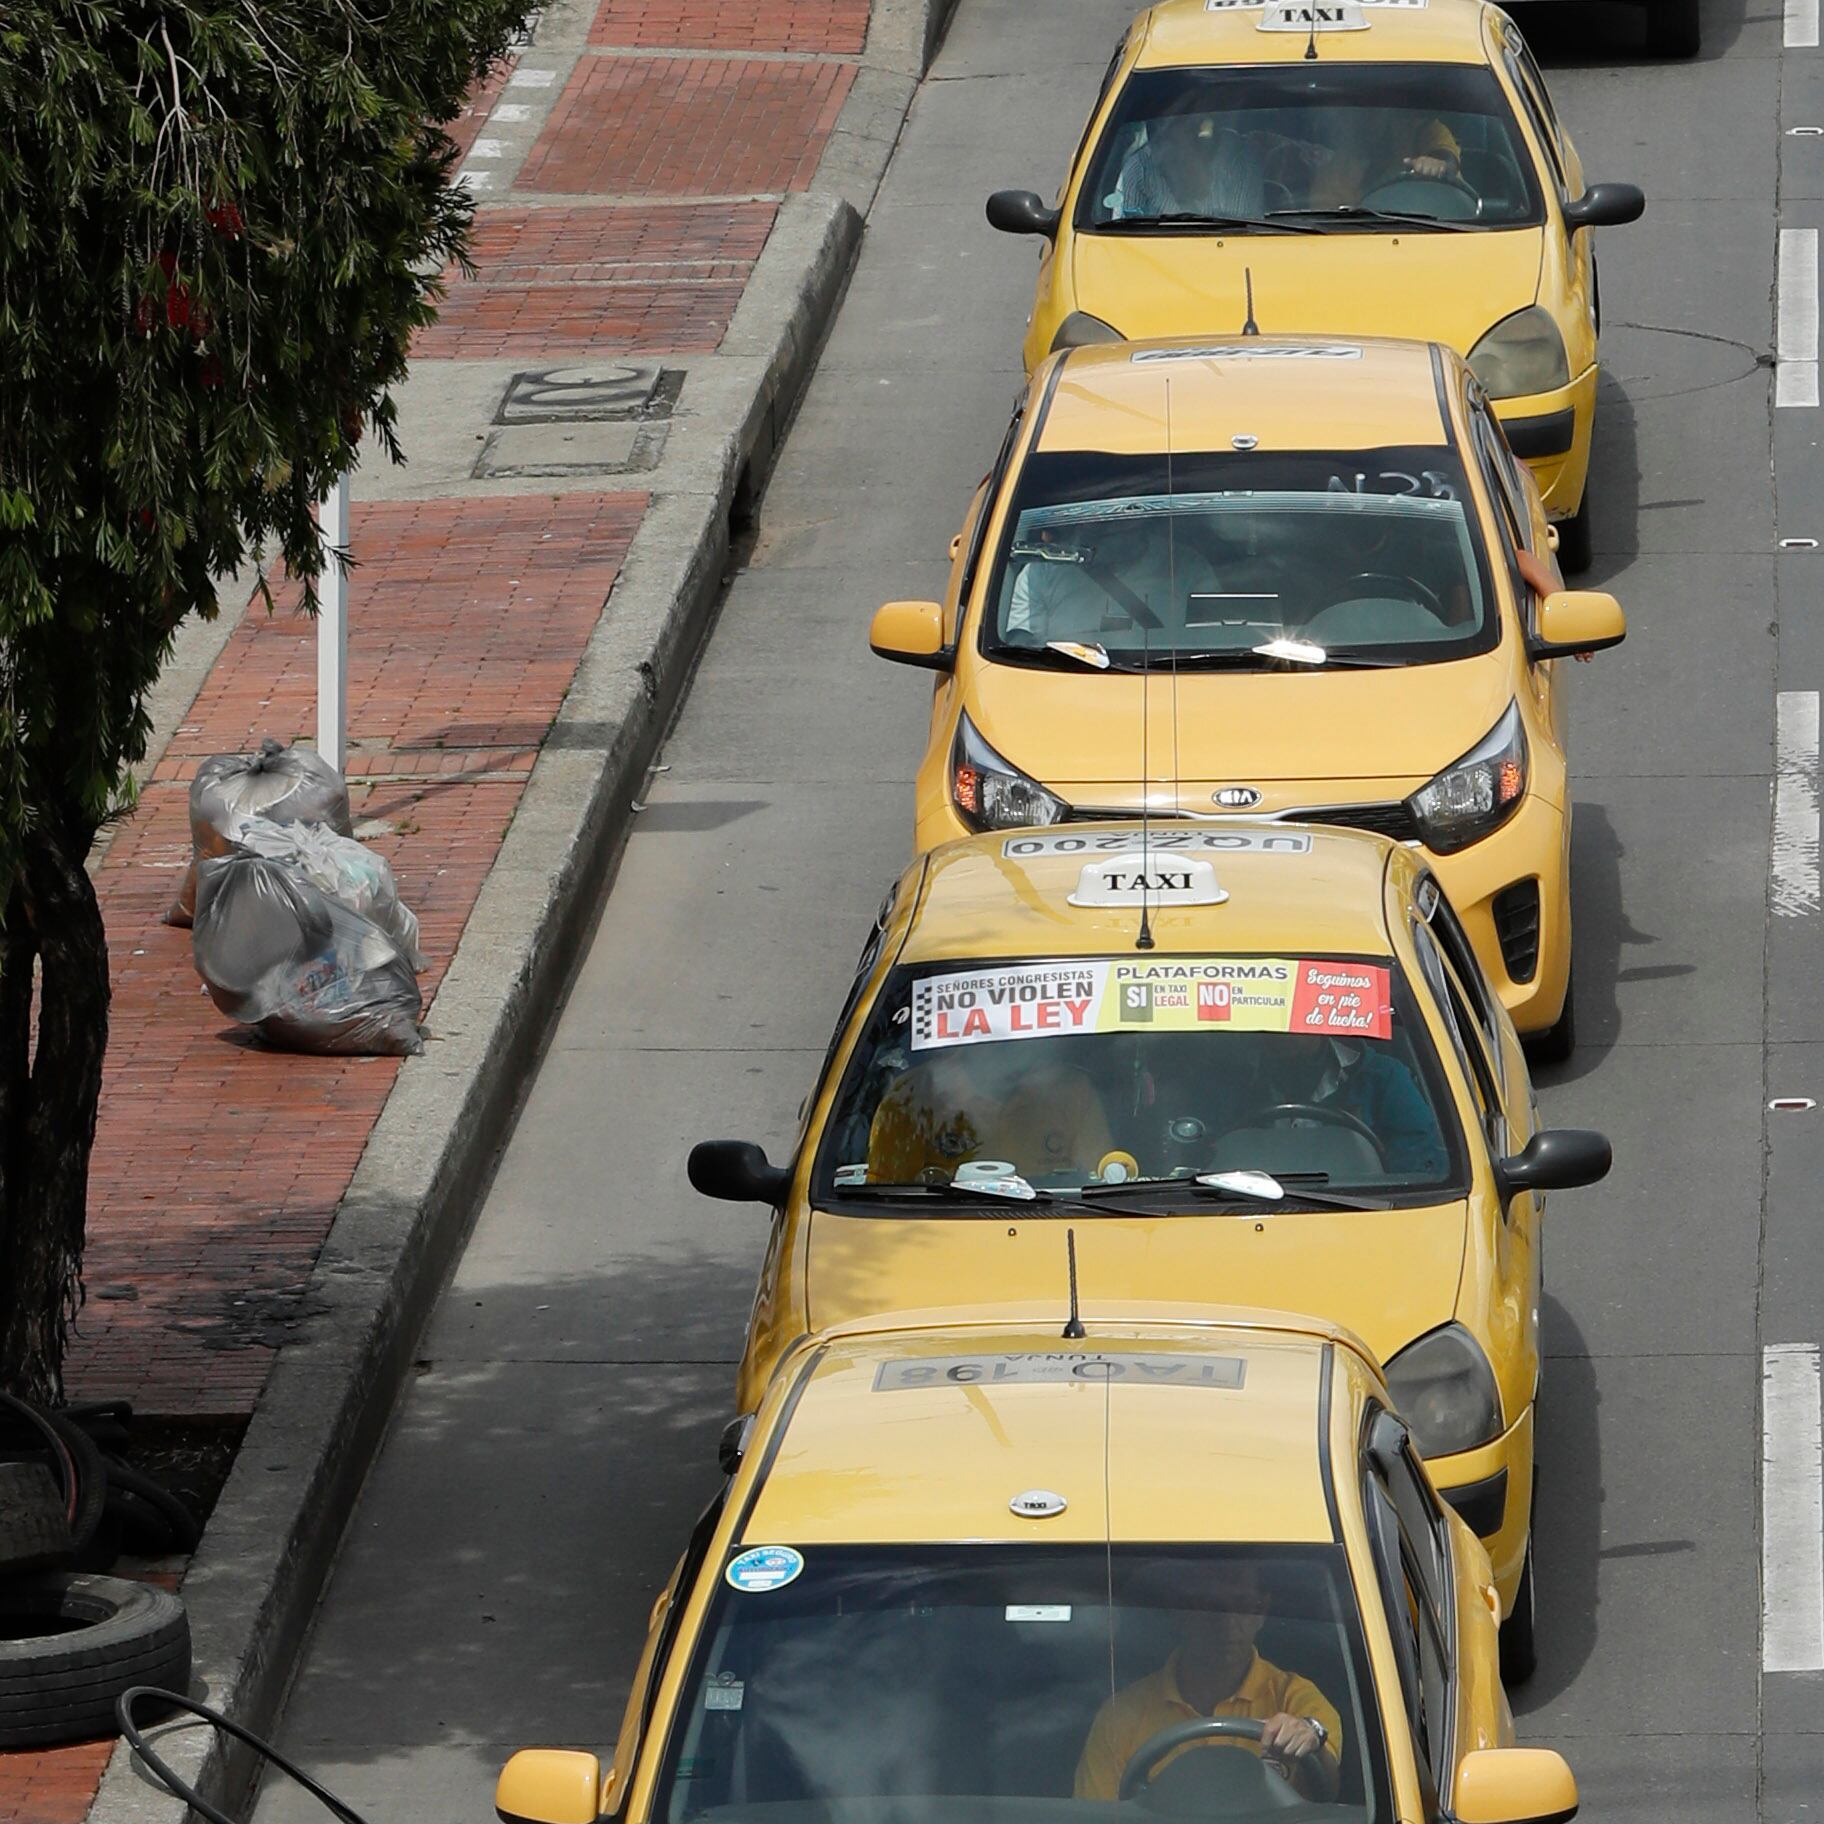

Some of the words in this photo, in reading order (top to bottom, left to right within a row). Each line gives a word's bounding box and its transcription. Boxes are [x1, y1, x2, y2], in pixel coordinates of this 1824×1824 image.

[1280, 7, 1345, 23] TAXI
[1215, 789, 1260, 806] KIA
[1011, 837, 1127, 855] 200
[1103, 873, 1195, 891] TAXI
[936, 977, 995, 994] SEÑORES
[998, 969, 1094, 987] CONGRESISTAS
[1117, 966, 1288, 980] PLATAFORMAS
[1306, 967, 1372, 990] Seguimos
[936, 991, 976, 1011] NO
[987, 981, 1094, 1005] VIOLEN
[1126, 985, 1147, 1009] SI
[1154, 985, 1166, 994] EN
[1168, 984, 1188, 994] TAXI
[1199, 985, 1229, 1007] NO
[1231, 986, 1244, 996] EN
[1154, 995, 1190, 1007] LEGAL
[1231, 995, 1286, 1007] PARTICULAR
[1317, 994, 1336, 1006] en
[1337, 993, 1361, 1010] pie
[936, 1008, 992, 1040] LA
[1010, 999, 1093, 1032] LEY
[1305, 1010, 1325, 1026] de
[1327, 1010, 1374, 1029] lucha!
[900, 1362, 1019, 1385] 198
[1070, 1360, 1234, 1384] TAO
